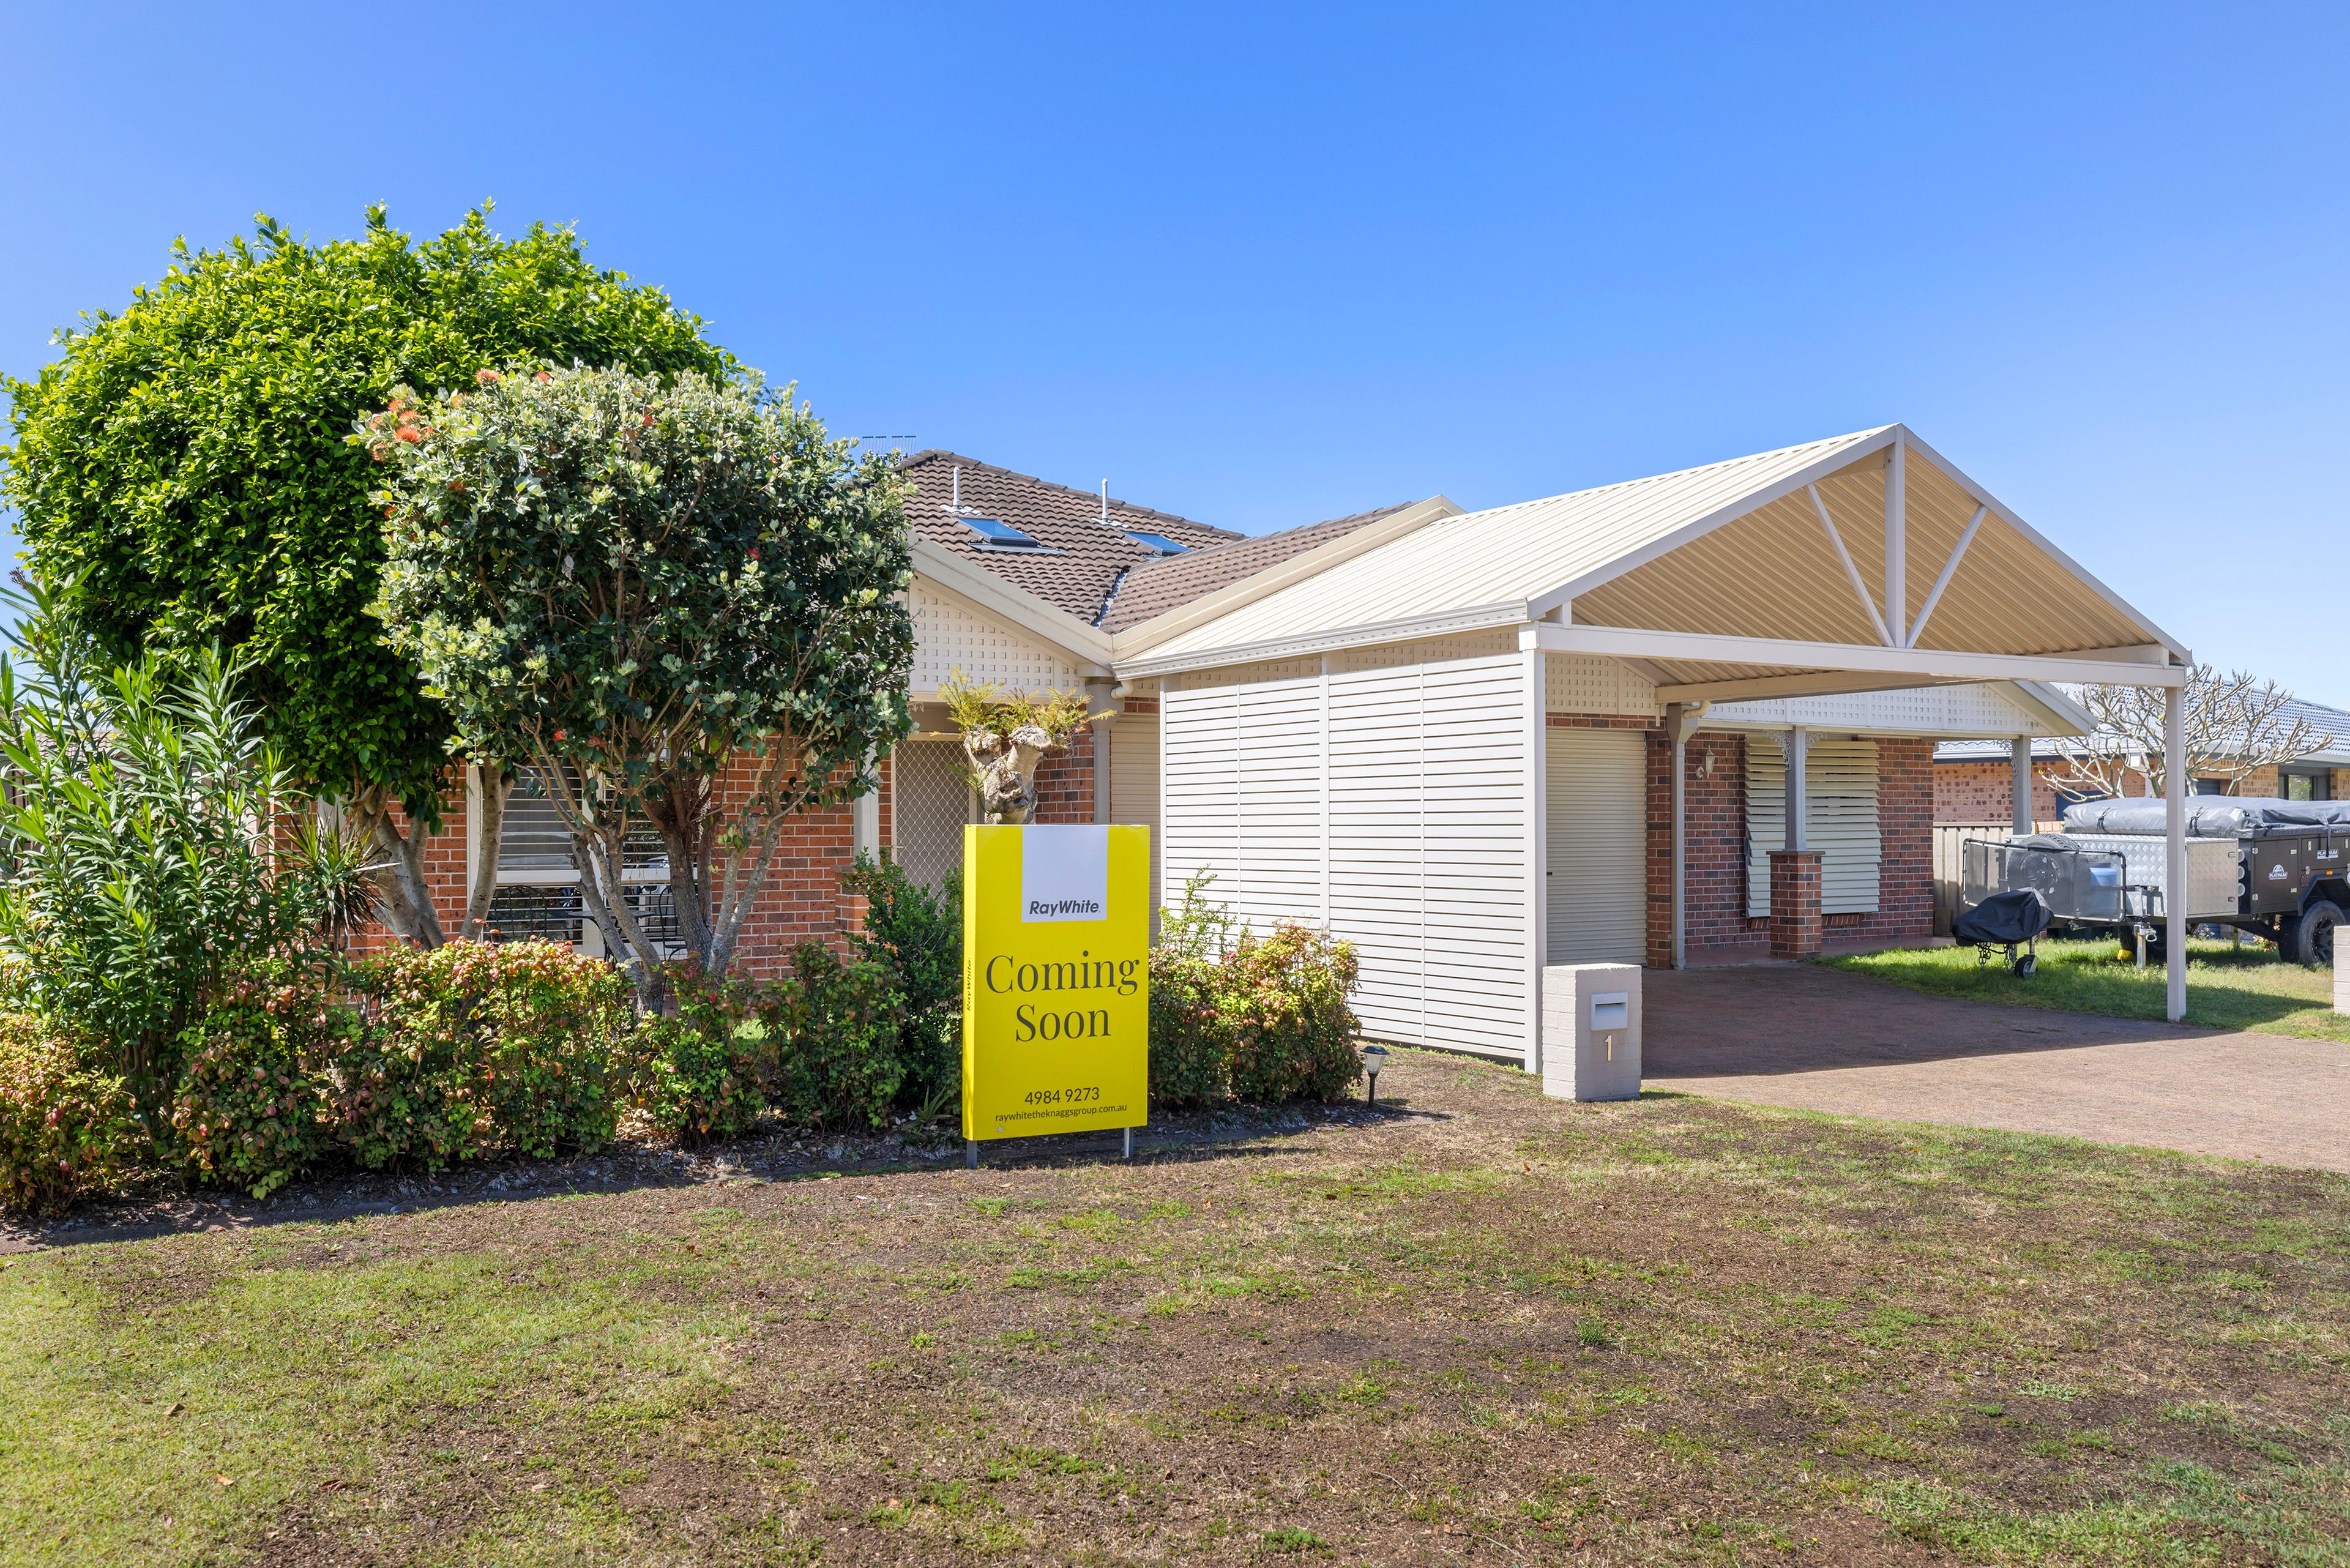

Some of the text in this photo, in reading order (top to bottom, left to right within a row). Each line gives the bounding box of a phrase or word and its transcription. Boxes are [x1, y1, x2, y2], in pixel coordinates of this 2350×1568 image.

[987, 950, 1140, 996] Coming
[1016, 1004, 1111, 1042] Soon
[1605, 1035, 1612, 1062] 1
[1024, 1087, 1100, 1105] 4984 9273
[995, 1104, 1127, 1122] raywhitetheknaggsgroup.com.au
